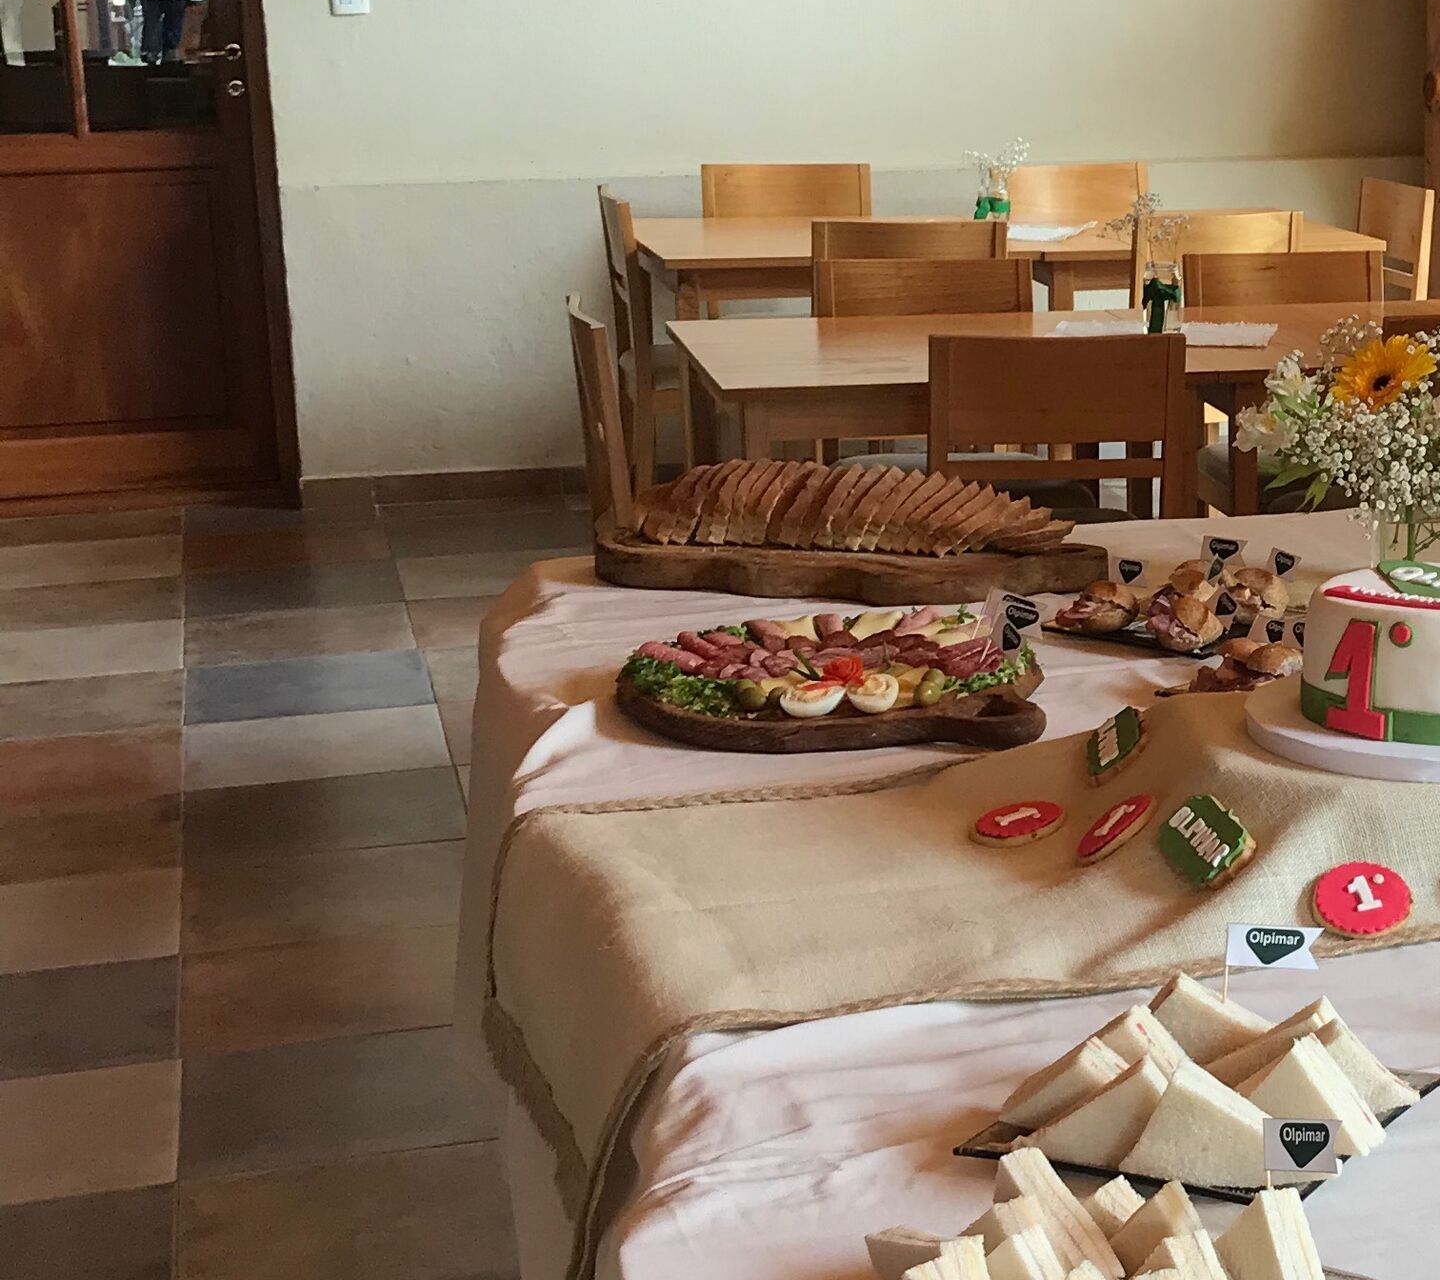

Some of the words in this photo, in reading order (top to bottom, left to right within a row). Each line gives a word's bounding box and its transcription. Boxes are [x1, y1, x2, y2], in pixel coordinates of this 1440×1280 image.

[1168, 806, 1230, 867] OLPIMAR
[1248, 929, 1300, 948] Olpimar
[1282, 1126, 1326, 1145] Olpimar
